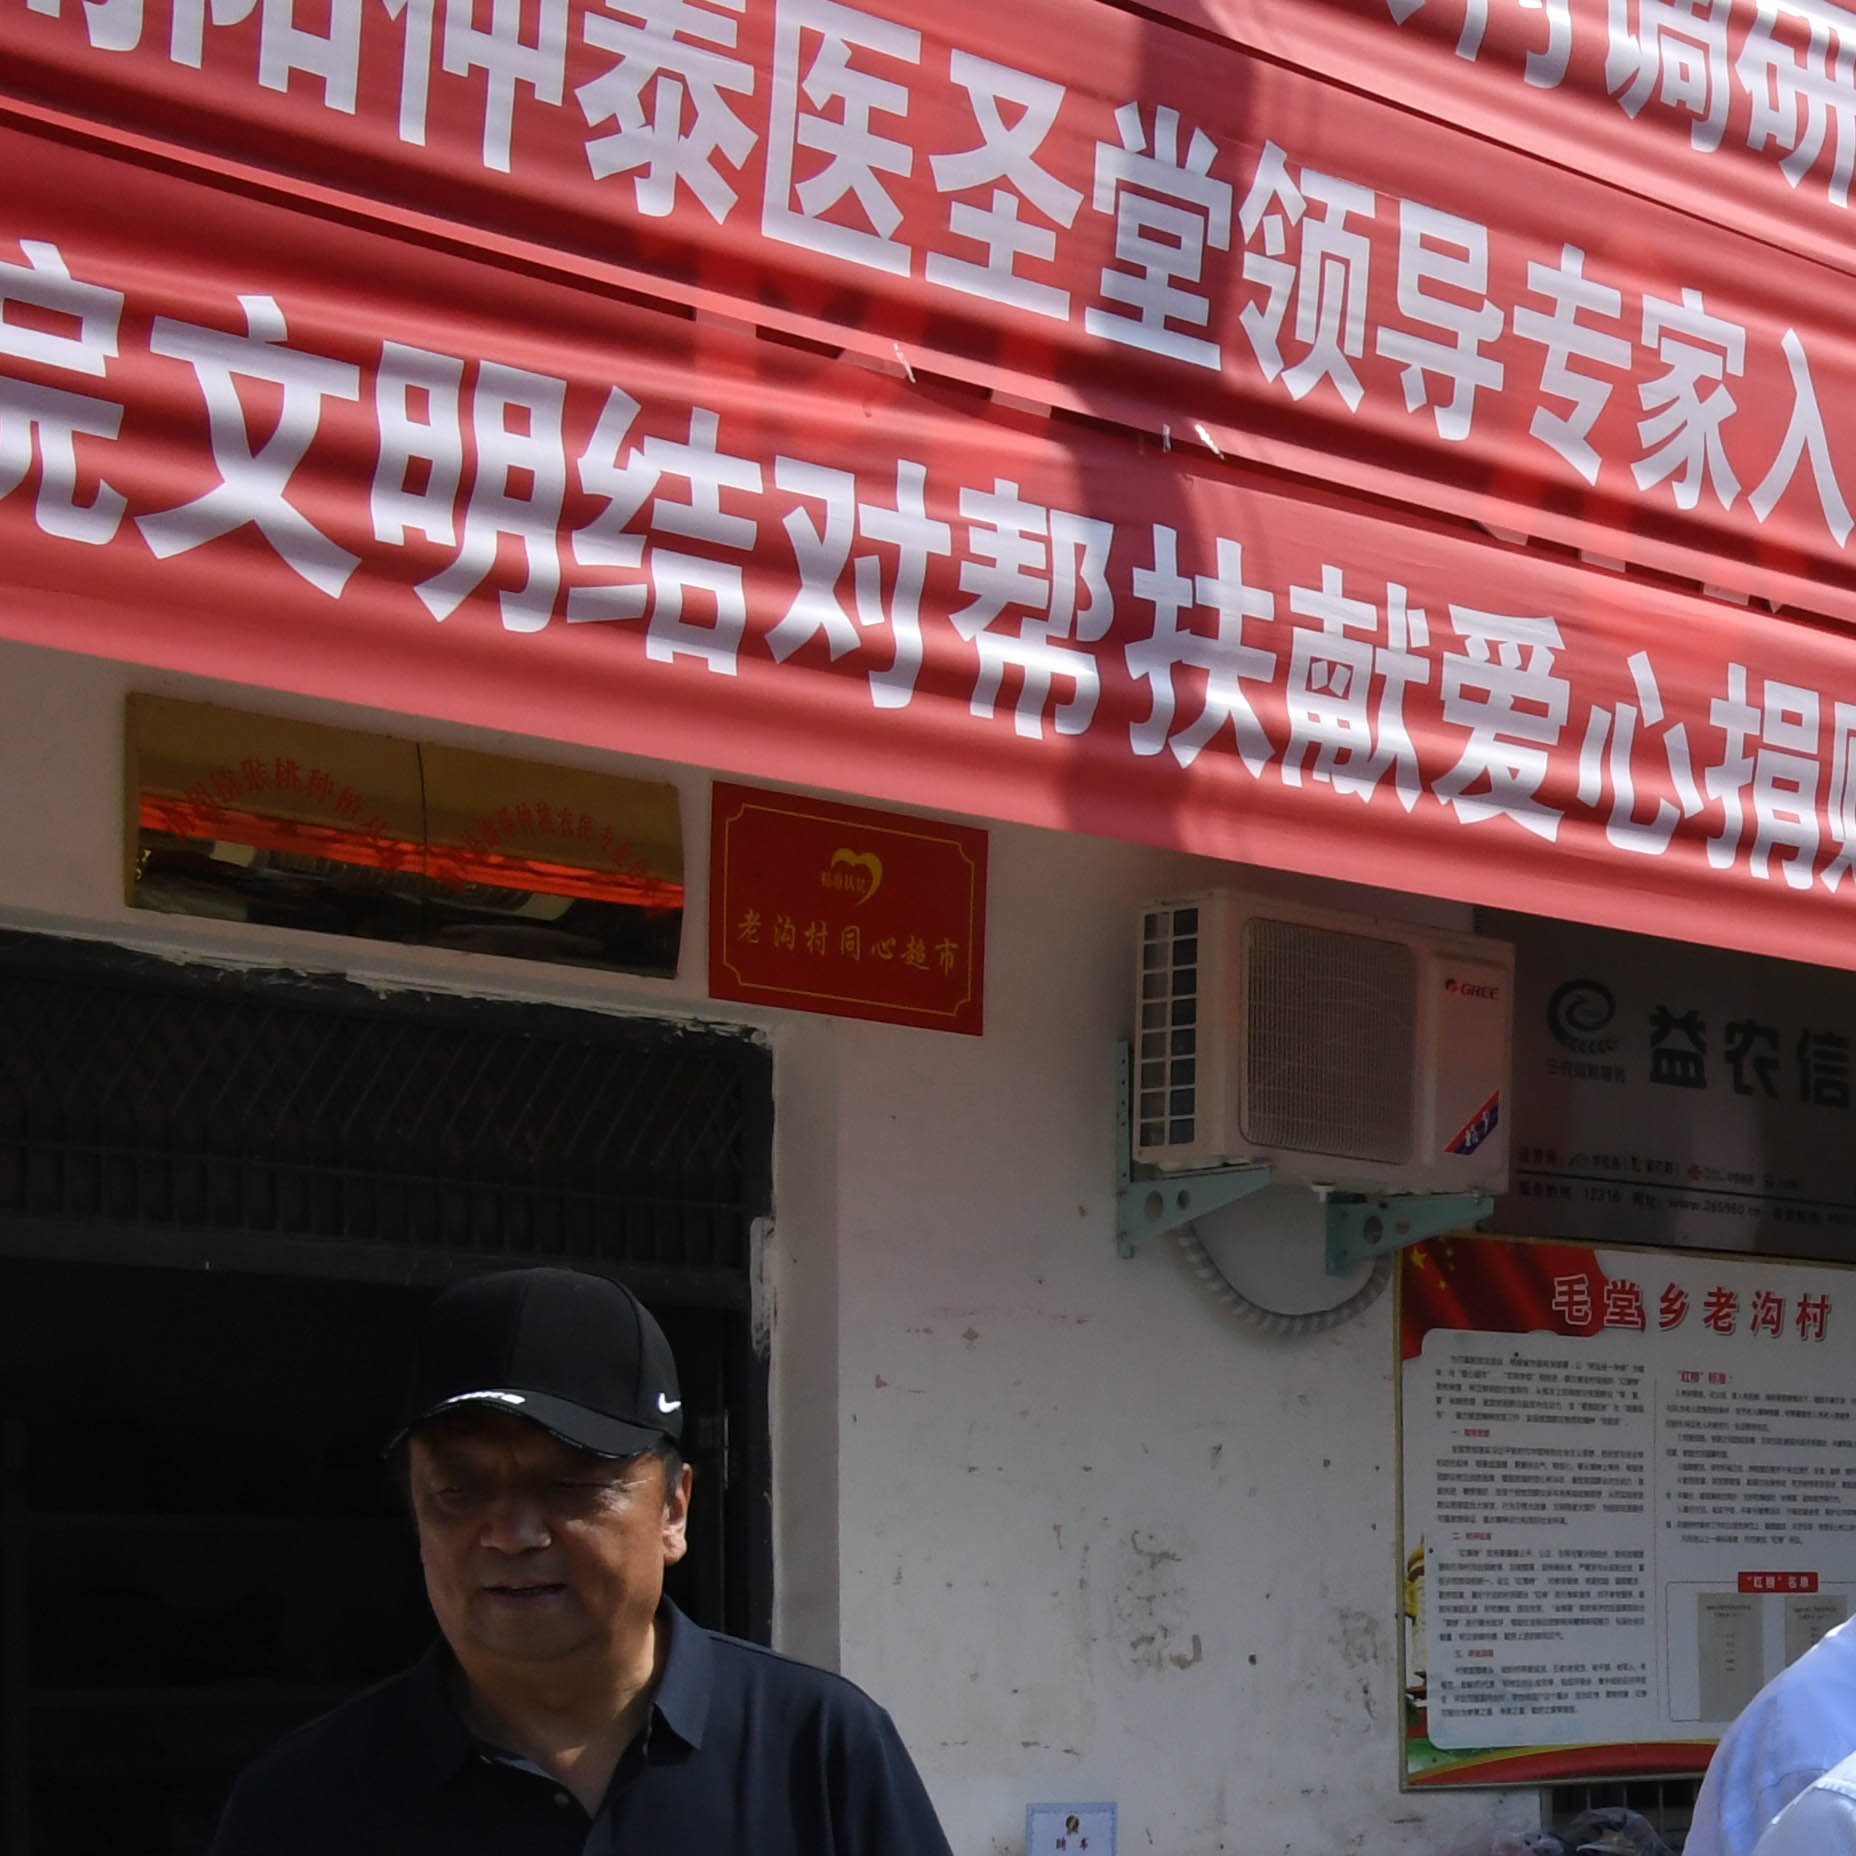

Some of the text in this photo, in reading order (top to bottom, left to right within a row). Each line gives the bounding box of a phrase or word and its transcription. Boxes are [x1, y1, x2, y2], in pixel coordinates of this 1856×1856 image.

[738, 909, 958, 976] 老沟村同心超市
